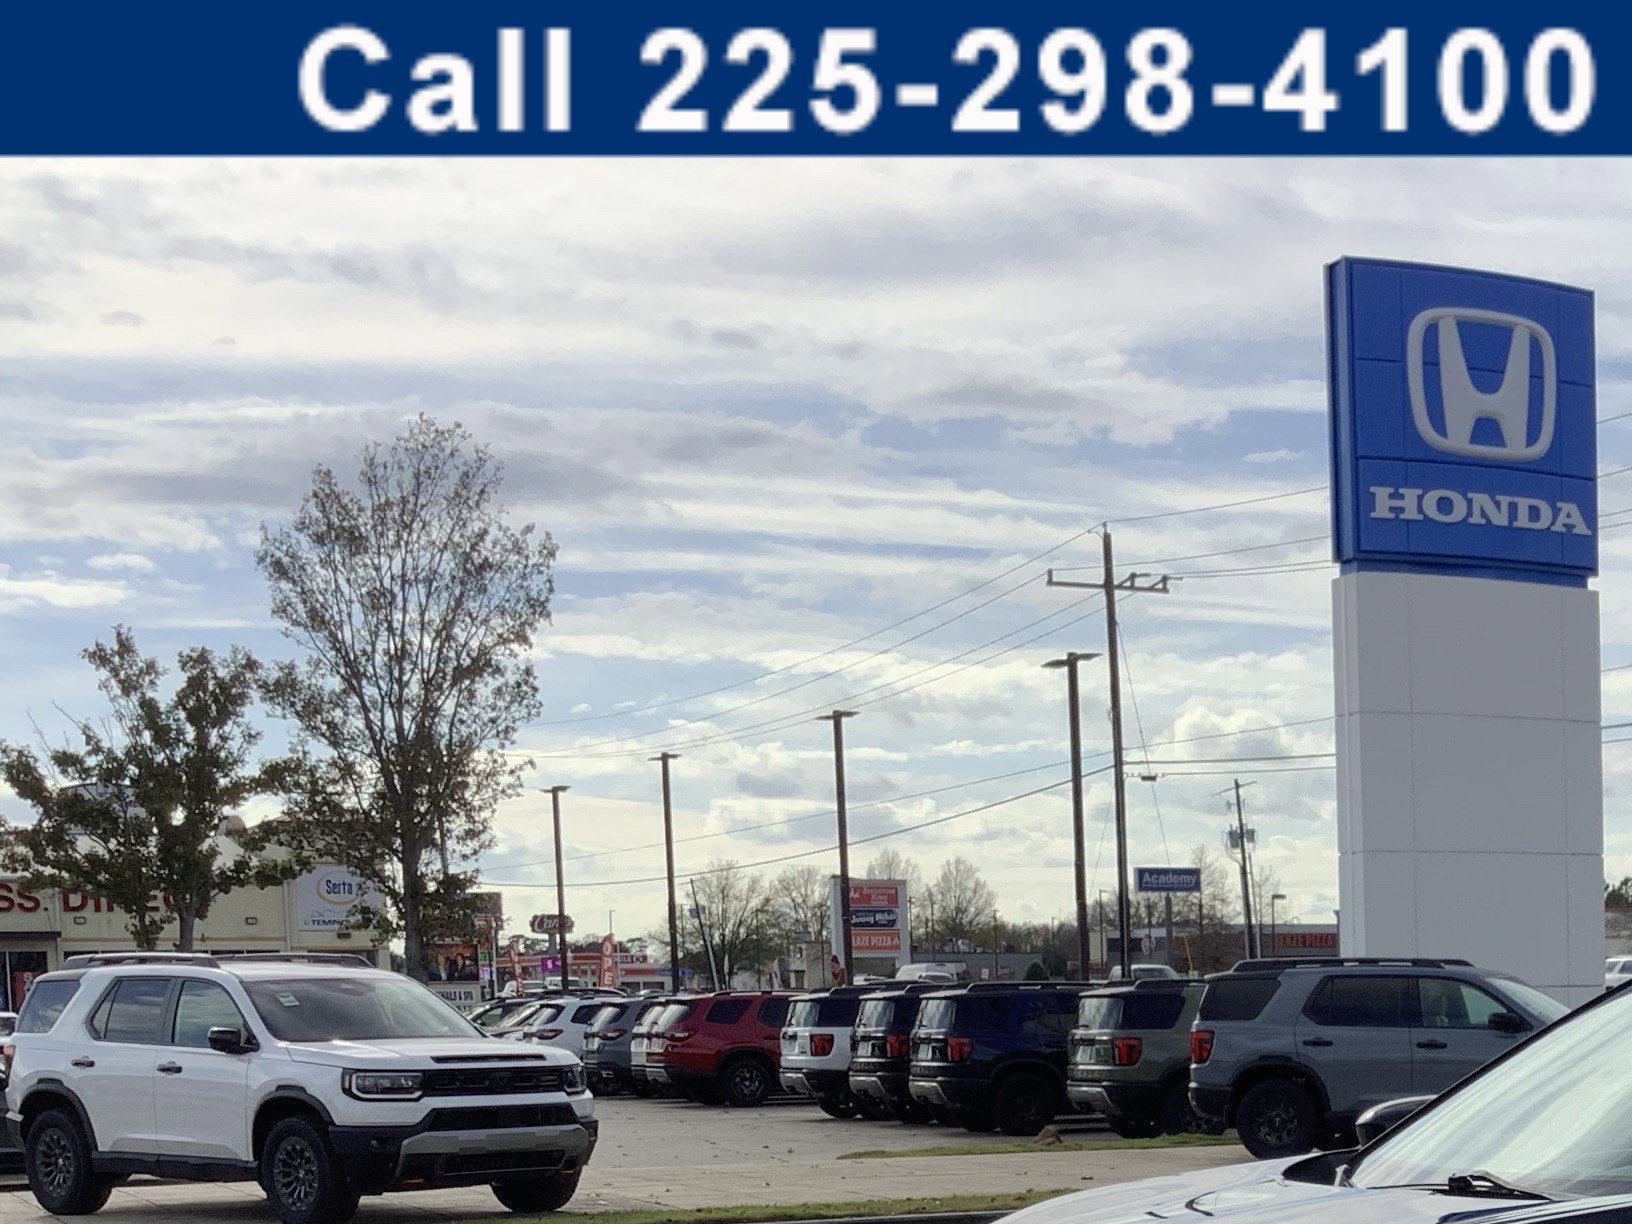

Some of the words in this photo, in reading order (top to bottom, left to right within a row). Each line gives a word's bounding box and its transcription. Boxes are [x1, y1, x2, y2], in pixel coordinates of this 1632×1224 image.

[1369, 486, 1592, 536] HONDA
[325, 879, 353, 895] Serta
[1142, 872, 1197, 888] Academy
